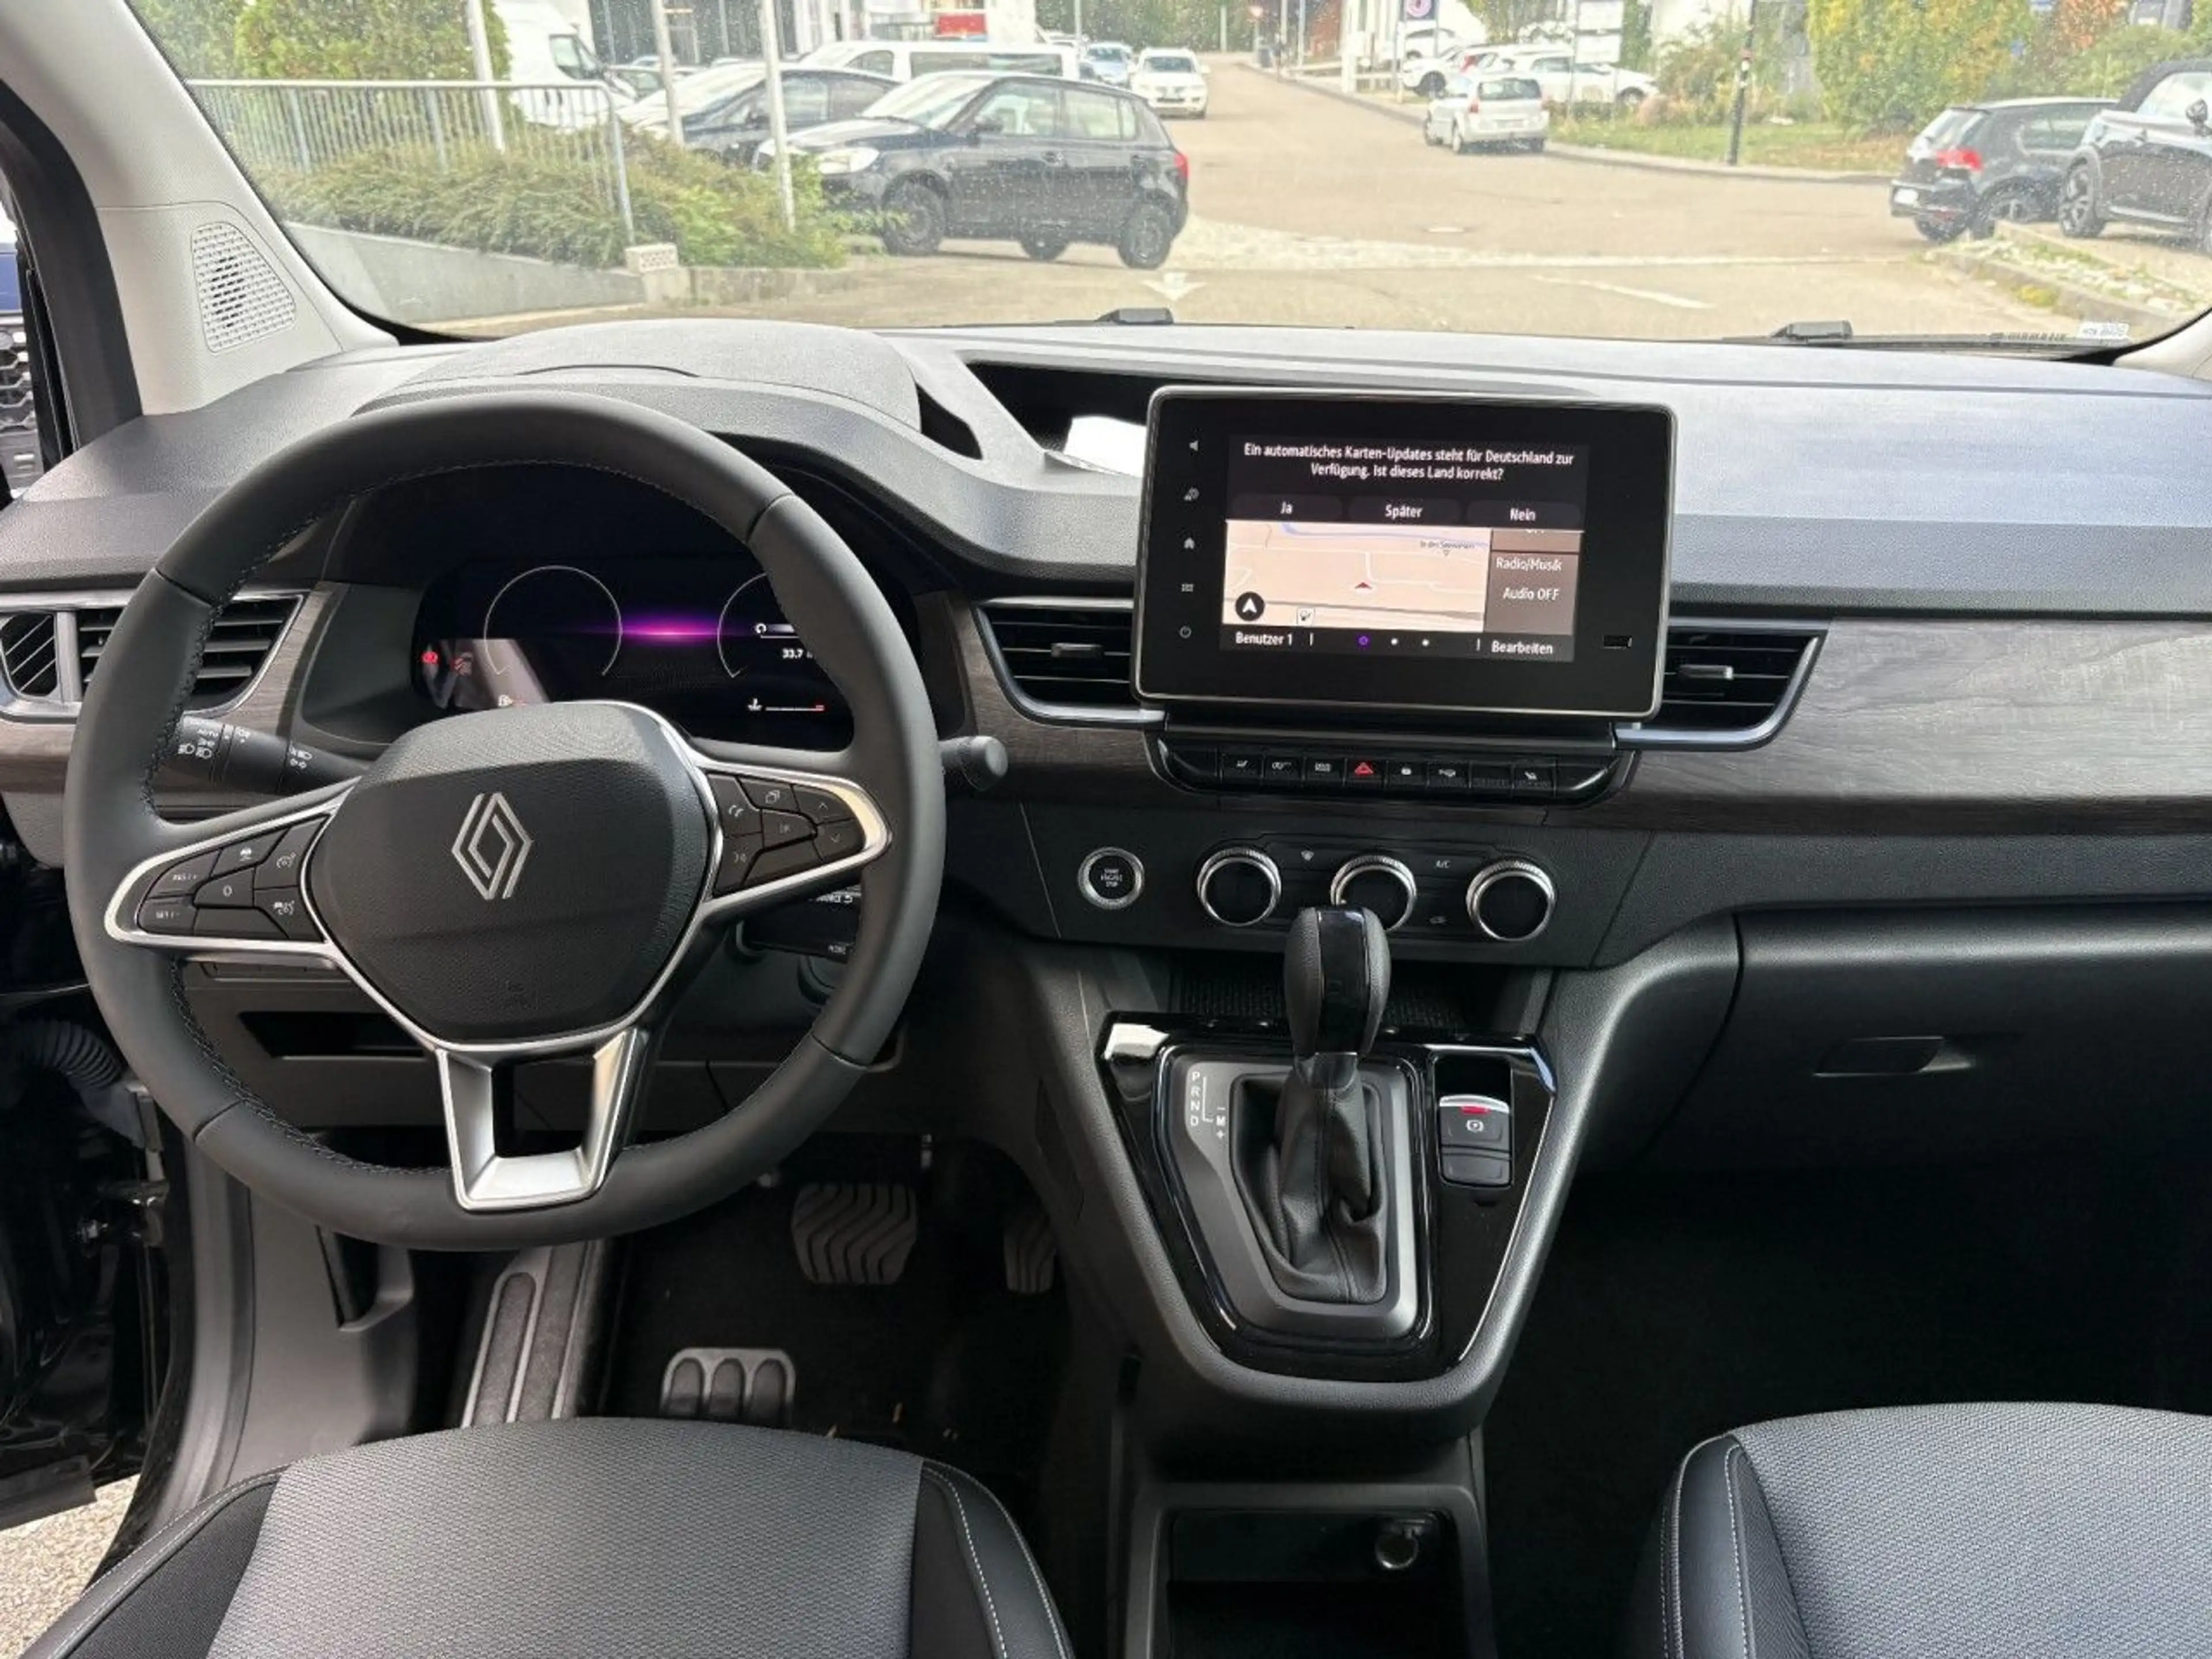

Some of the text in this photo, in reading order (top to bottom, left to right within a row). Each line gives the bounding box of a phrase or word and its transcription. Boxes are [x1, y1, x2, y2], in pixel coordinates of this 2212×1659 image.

[1244, 442, 1574, 465] Ein automatisches Karten-Updates steht für Deutschland zur
[1311, 462, 1504, 480] Verfügung. Ist dieses Land korrekt?
[1281, 501, 1293, 514] Ja
[1385, 503, 1423, 520] Später
[1510, 507, 1536, 521] Nein
[1496, 557, 1563, 572] Radio/Musik
[1503, 587, 1560, 601] Audio OFF
[1235, 631, 1293, 646] Benutzer 1
[1491, 639, 1554, 655] Bearbeiten
[1192, 1071, 1200, 1081] P
[1191, 1086, 1200, 1097] R
[1191, 1100, 1200, 1111] N
[1191, 1115, 1198, 1126] D
[1217, 1115, 1226, 1126] M
